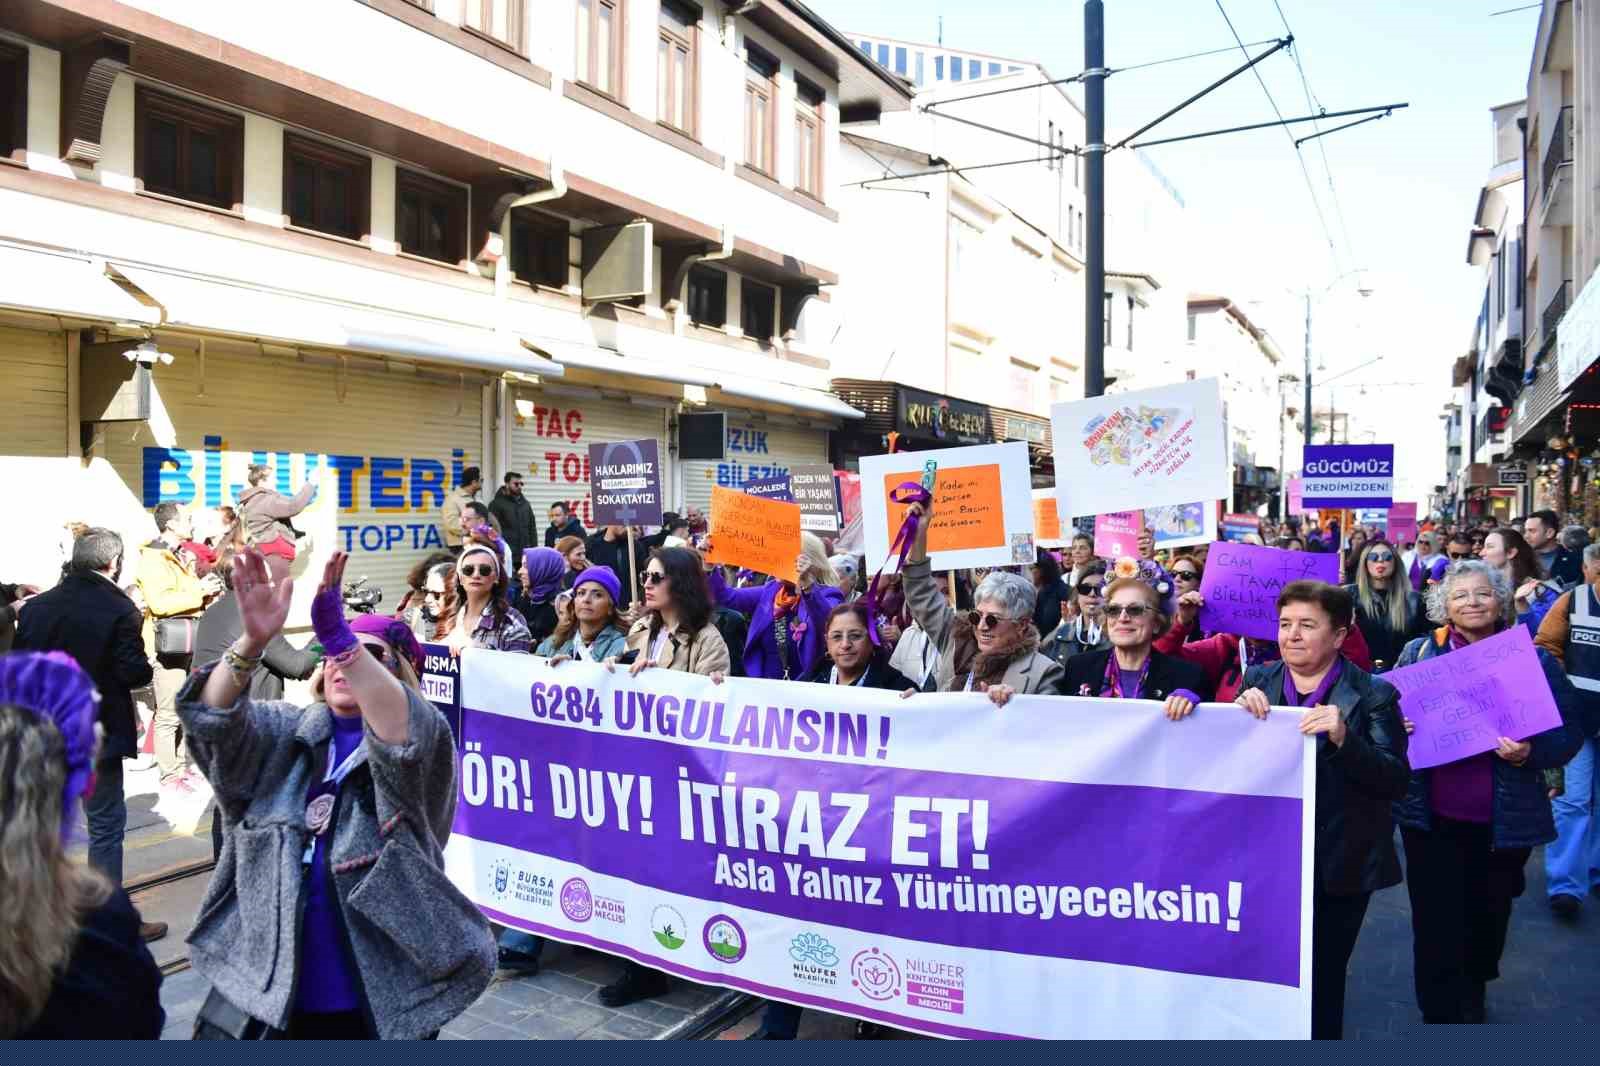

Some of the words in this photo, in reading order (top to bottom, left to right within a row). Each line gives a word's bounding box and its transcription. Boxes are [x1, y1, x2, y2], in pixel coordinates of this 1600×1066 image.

[533, 406, 583, 443] TAÇ
[595, 463, 653, 476] HAKLARIMIZ
[1306, 459, 1390, 474] GÜCÜMÜZ
[1305, 481, 1389, 493] KENDİMİZDEN!
[597, 493, 655, 505] SOKAKTAYIZ!
[1217, 552, 1253, 569] CAM
[530, 681, 603, 727] 6284
[548, 762, 654, 836] DUY!
[677, 766, 870, 862] İTİRAZ
[891, 795, 990, 870] ET!
[518, 870, 554, 889] BURSA
[714, 852, 776, 894] Asla
[783, 862, 884, 906] Yalnız
[594, 900, 625, 914] KADIN
[793, 963, 837, 978] NİLÜFER
[906, 958, 964, 979] NİLÜFER
[920, 986, 949, 997] KADIN
